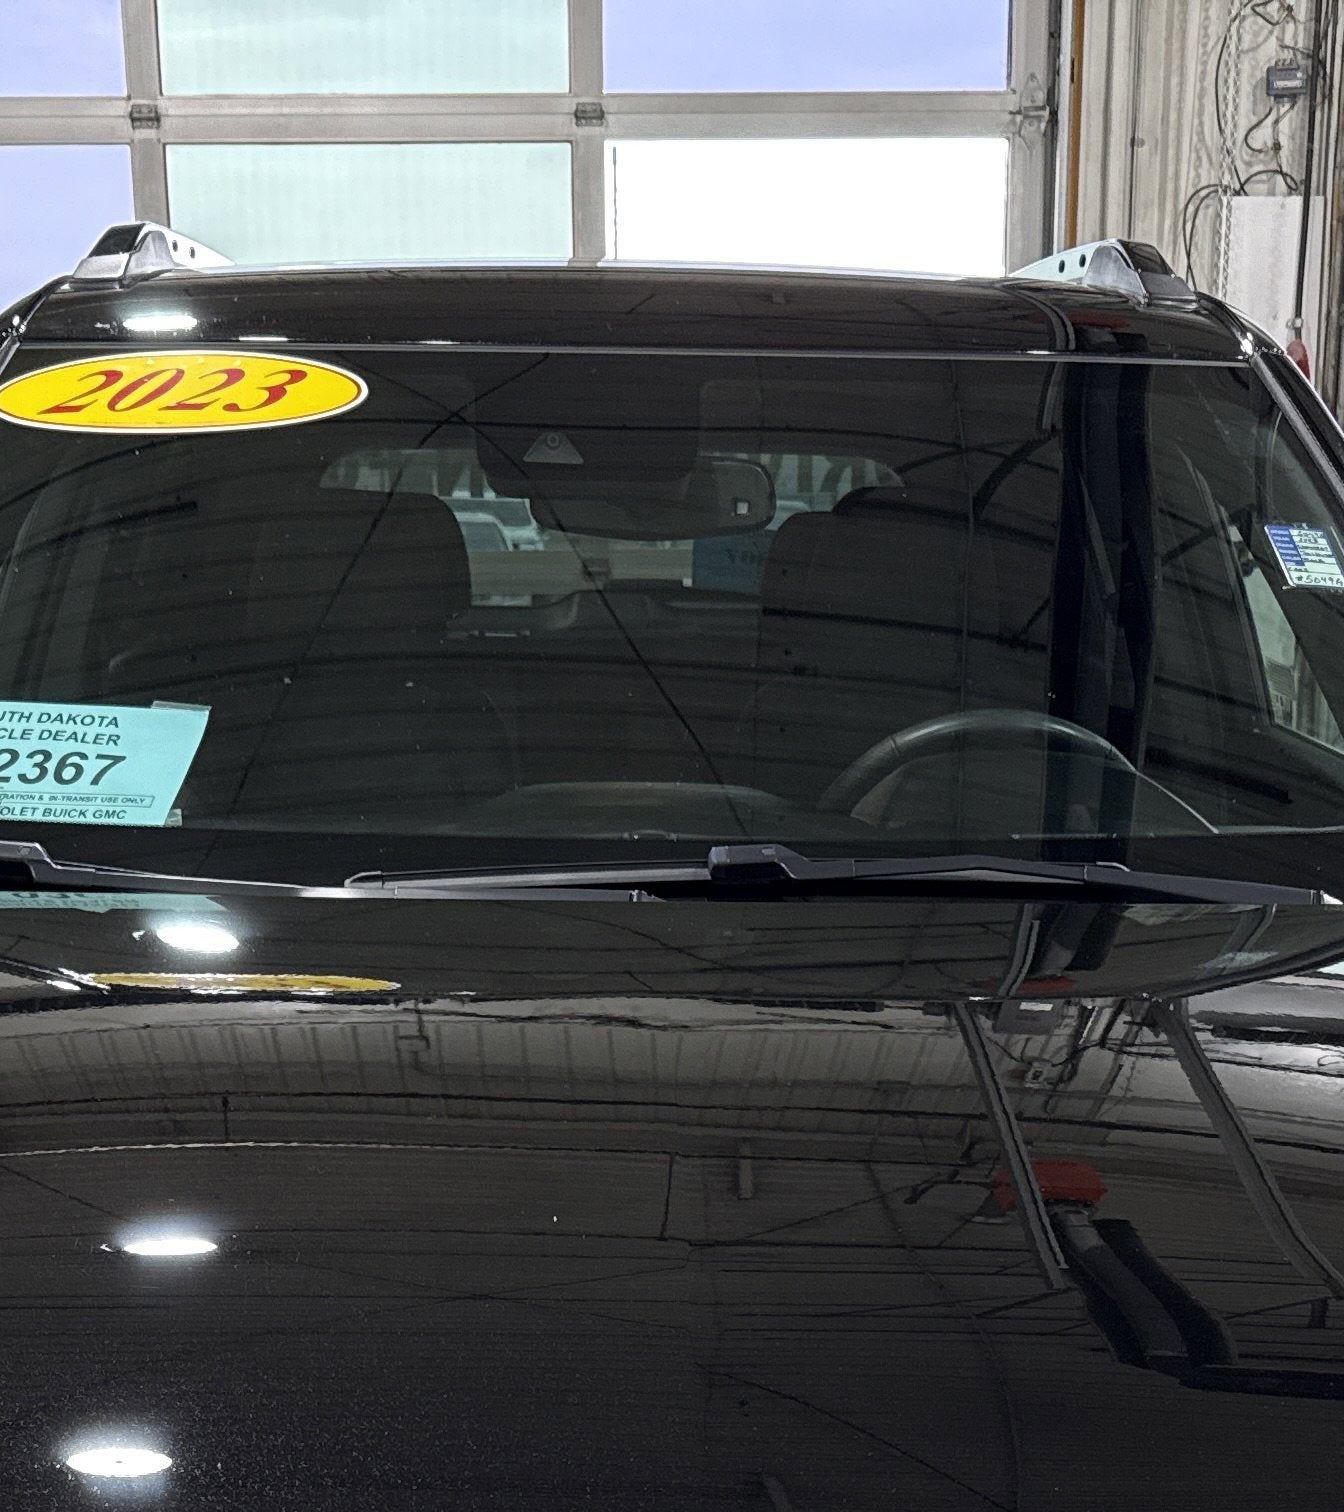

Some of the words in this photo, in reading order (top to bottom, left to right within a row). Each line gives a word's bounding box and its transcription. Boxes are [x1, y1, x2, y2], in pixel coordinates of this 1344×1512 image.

[37, 368, 308, 414] 2023
[37, 711, 120, 729] DAKOTA
[38, 728, 121, 747] DEALER
[121, 797, 146, 805] ONLY
[42, 807, 89, 820] BUICK
[92, 809, 128, 820] GMC
